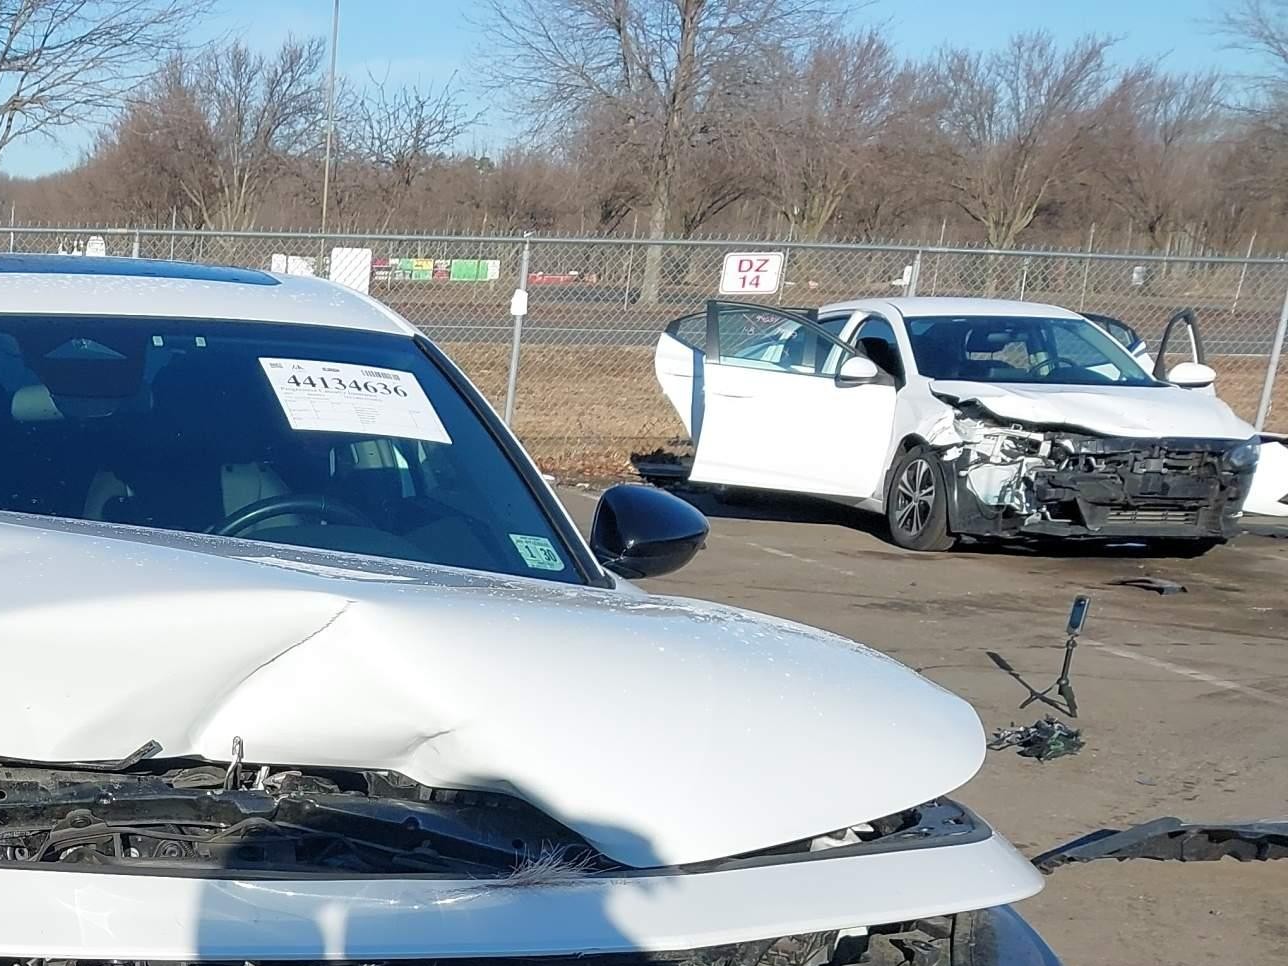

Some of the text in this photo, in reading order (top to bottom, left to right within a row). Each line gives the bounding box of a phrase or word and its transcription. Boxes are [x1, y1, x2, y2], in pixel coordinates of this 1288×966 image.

[738, 259, 770, 272] DZ
[738, 275, 760, 288] 14
[287, 374, 408, 398] 44134636
